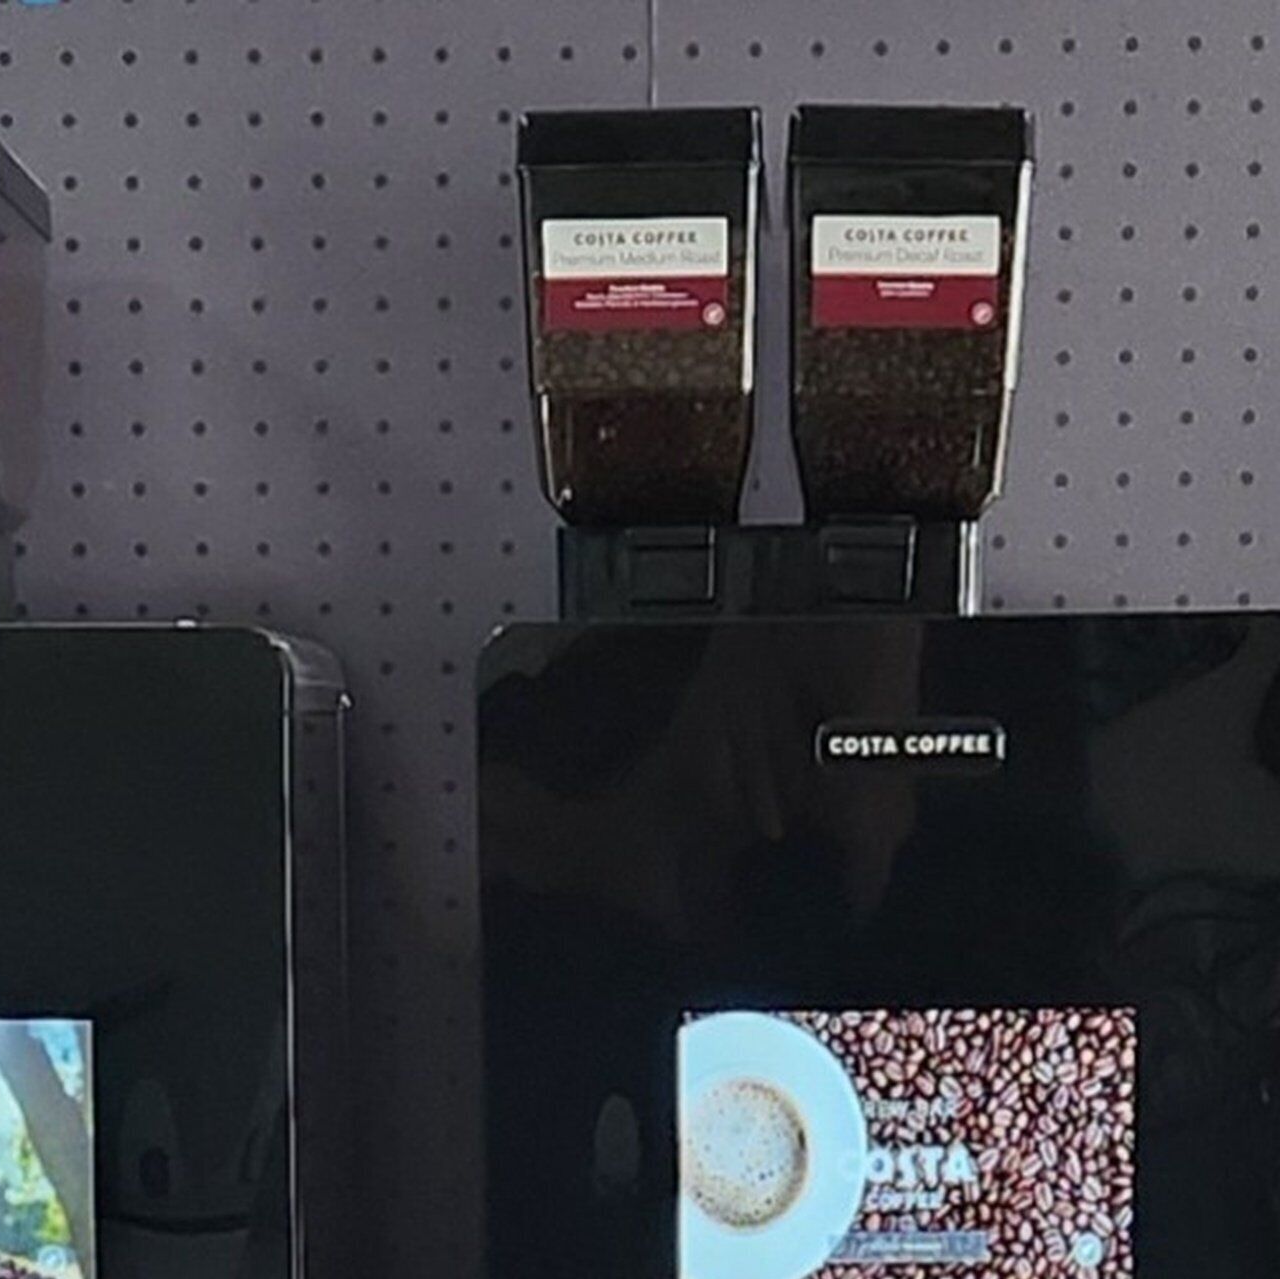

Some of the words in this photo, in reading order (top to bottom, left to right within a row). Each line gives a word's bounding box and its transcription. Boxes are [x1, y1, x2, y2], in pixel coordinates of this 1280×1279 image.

[573, 232, 626, 246] COSTA
[632, 230, 697, 245] COFFEE
[844, 228, 896, 242] COSTA
[903, 228, 968, 242] COFFEE
[827, 247, 893, 263] Premium
[828, 735, 899, 757] COSTA
[904, 734, 992, 755] COFFEE
